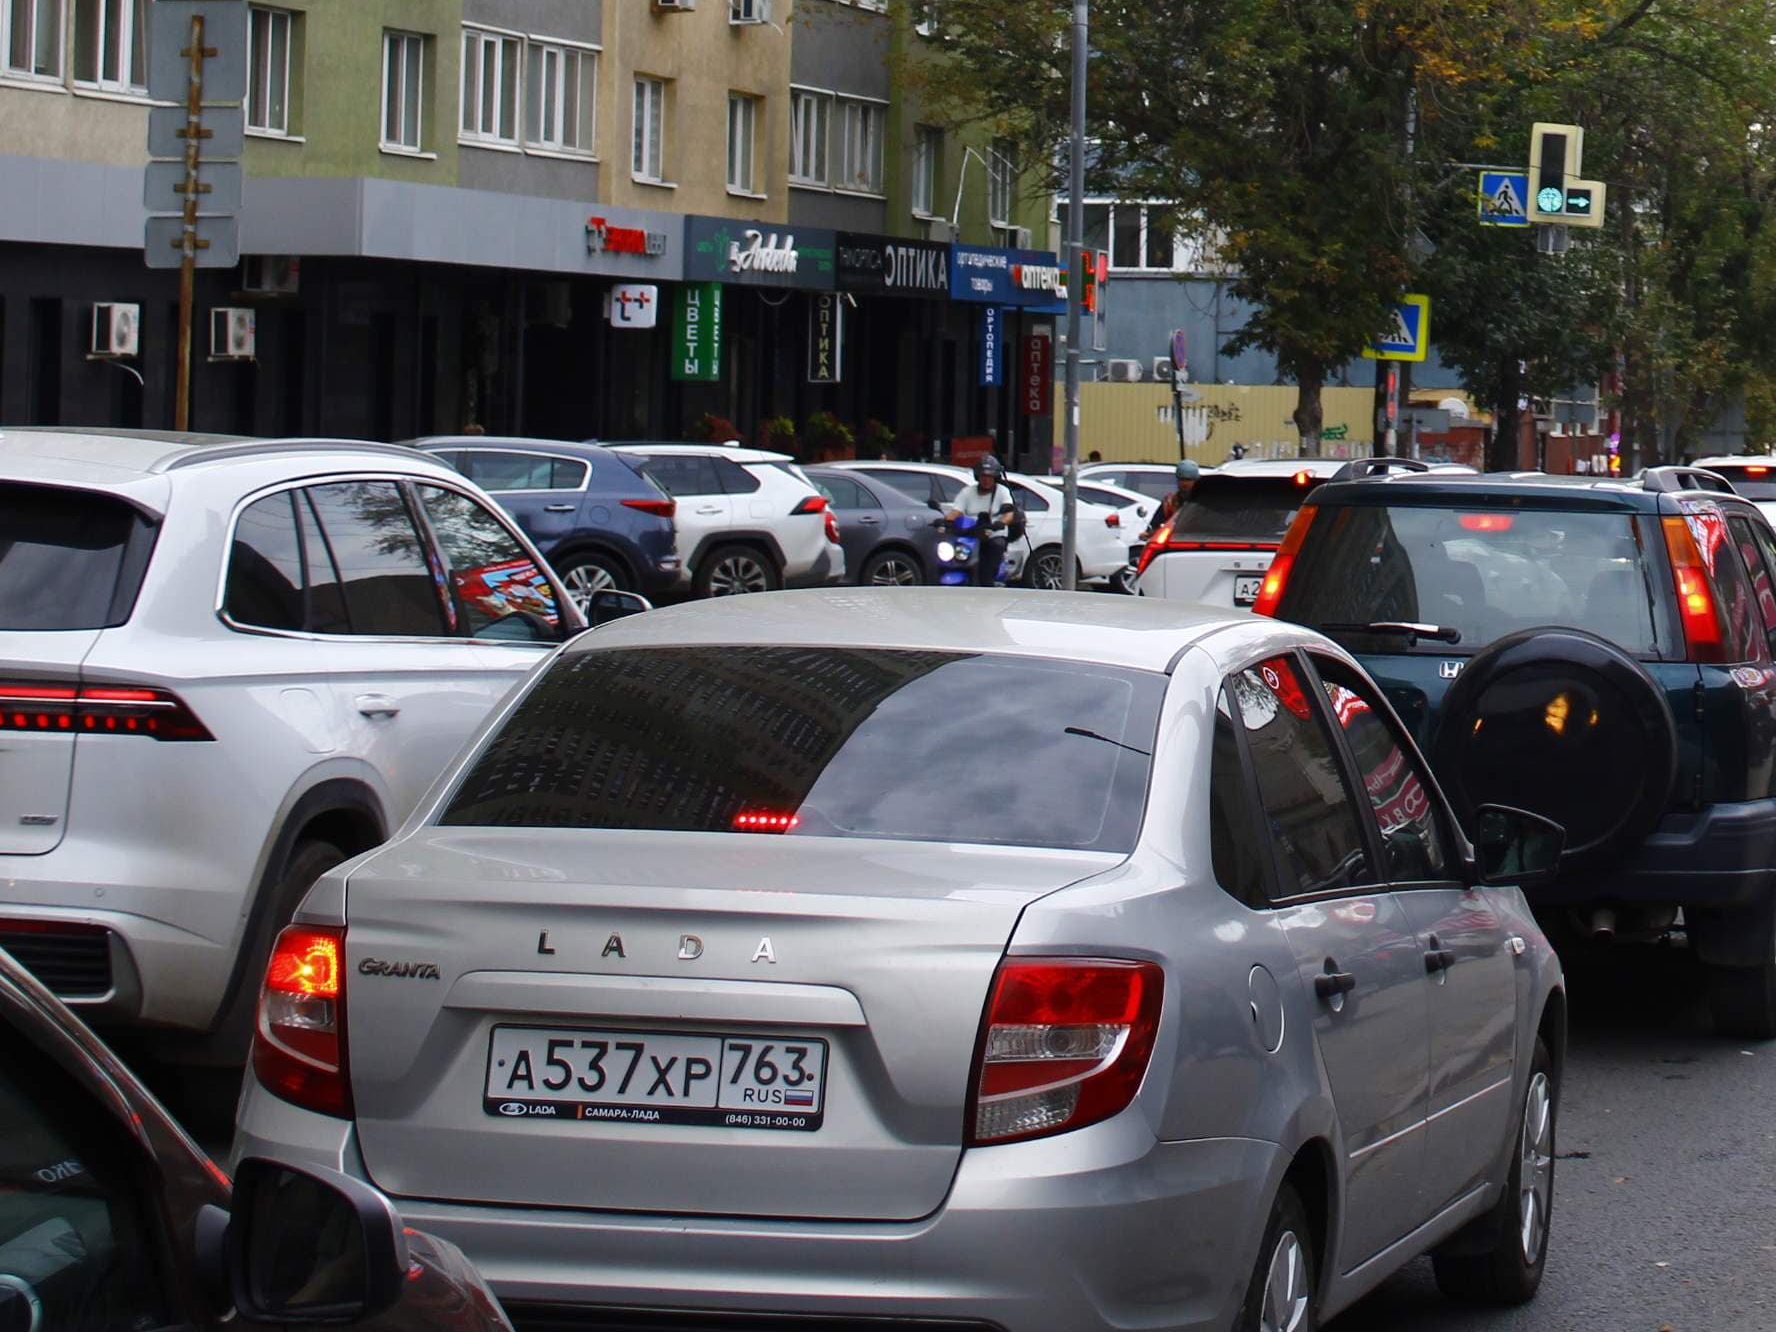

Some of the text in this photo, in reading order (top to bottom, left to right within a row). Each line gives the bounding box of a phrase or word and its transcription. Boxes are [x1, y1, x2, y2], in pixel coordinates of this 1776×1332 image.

[684, 289, 700, 375] ЦВЕТЫ
[818, 294, 832, 379] ОПТИКА
[985, 308, 995, 383] ОРТОПЕДИЯ
[536, 928, 778, 965] LADA
[357, 957, 441, 980] GRANTA
[506, 1039, 809, 1098] А537ХР 763
[528, 1105, 556, 1116] LADA
[743, 1088, 783, 1105] RUS
[585, 1106, 660, 1121] САМАРА-ЛАДА
[725, 1113, 807, 1127] (846) 331-00-00
